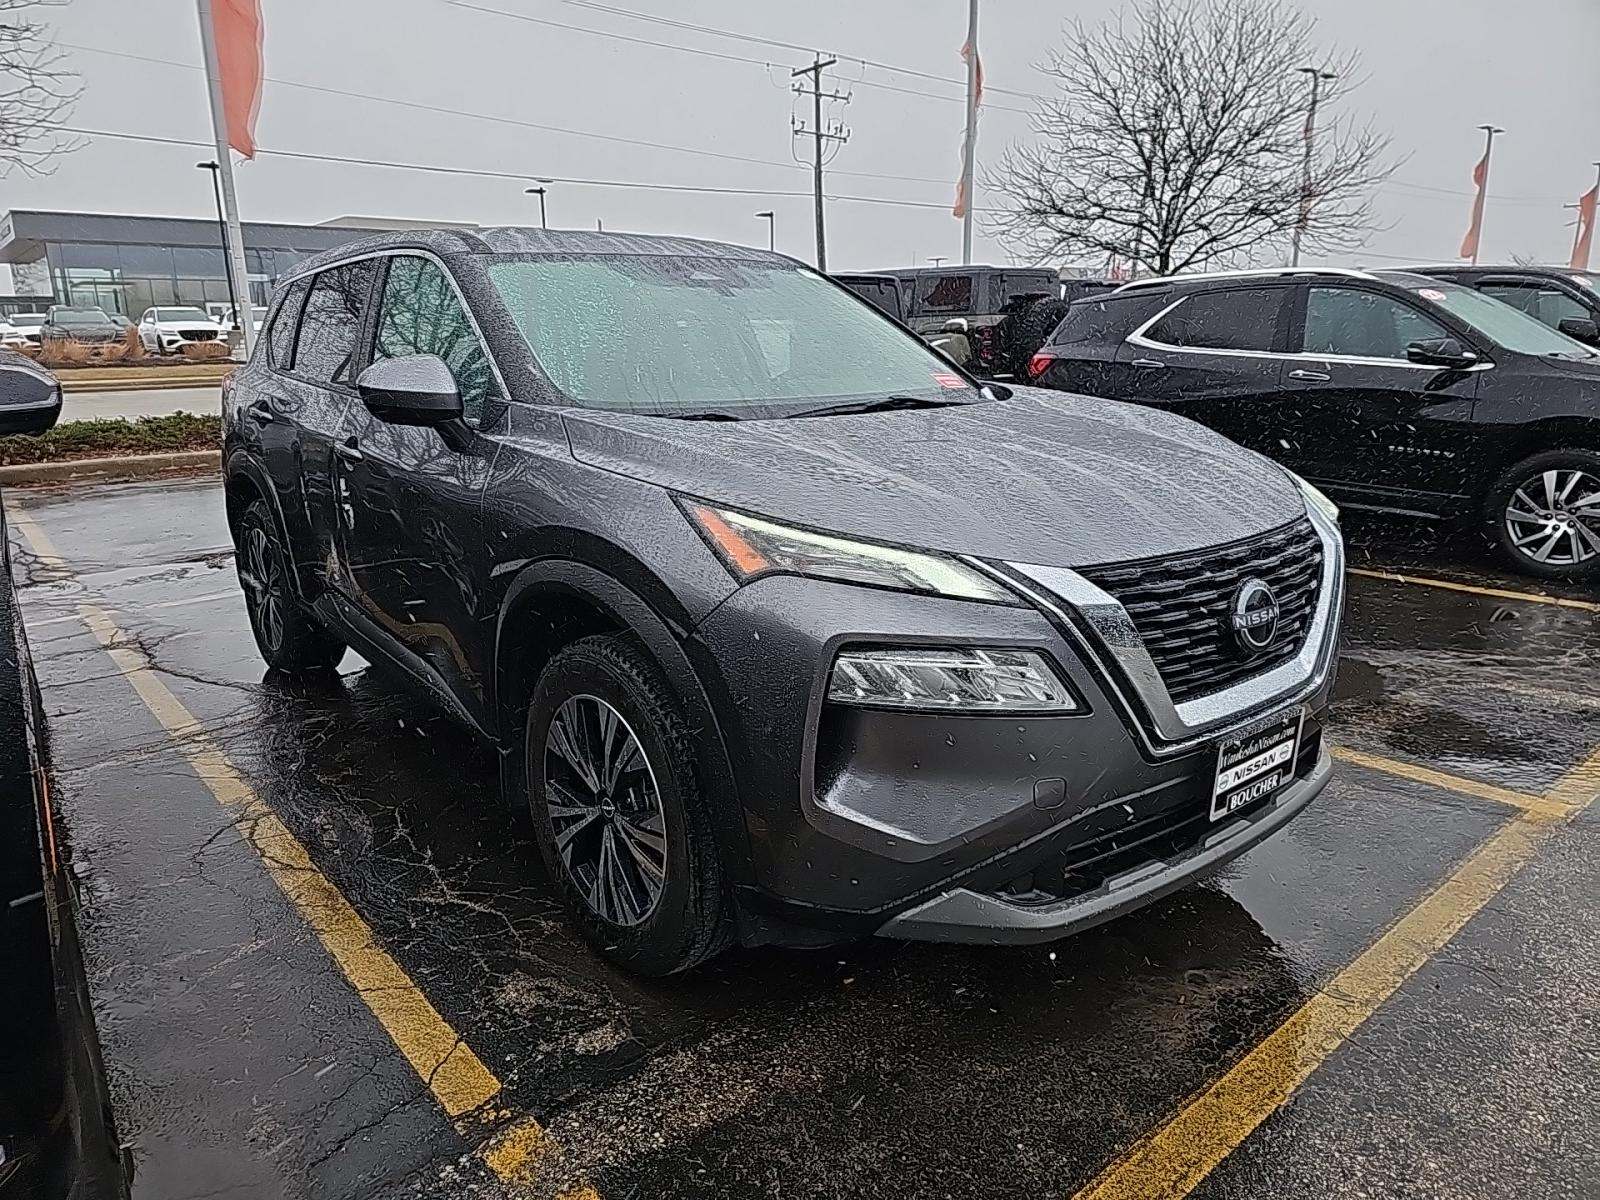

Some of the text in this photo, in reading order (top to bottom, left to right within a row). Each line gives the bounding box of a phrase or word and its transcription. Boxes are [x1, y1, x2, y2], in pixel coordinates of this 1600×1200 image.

[1235, 606, 1279, 628] NISSAN
[1233, 752, 1276, 783] NISSAN
[1230, 774, 1279, 810] BOUCHER
